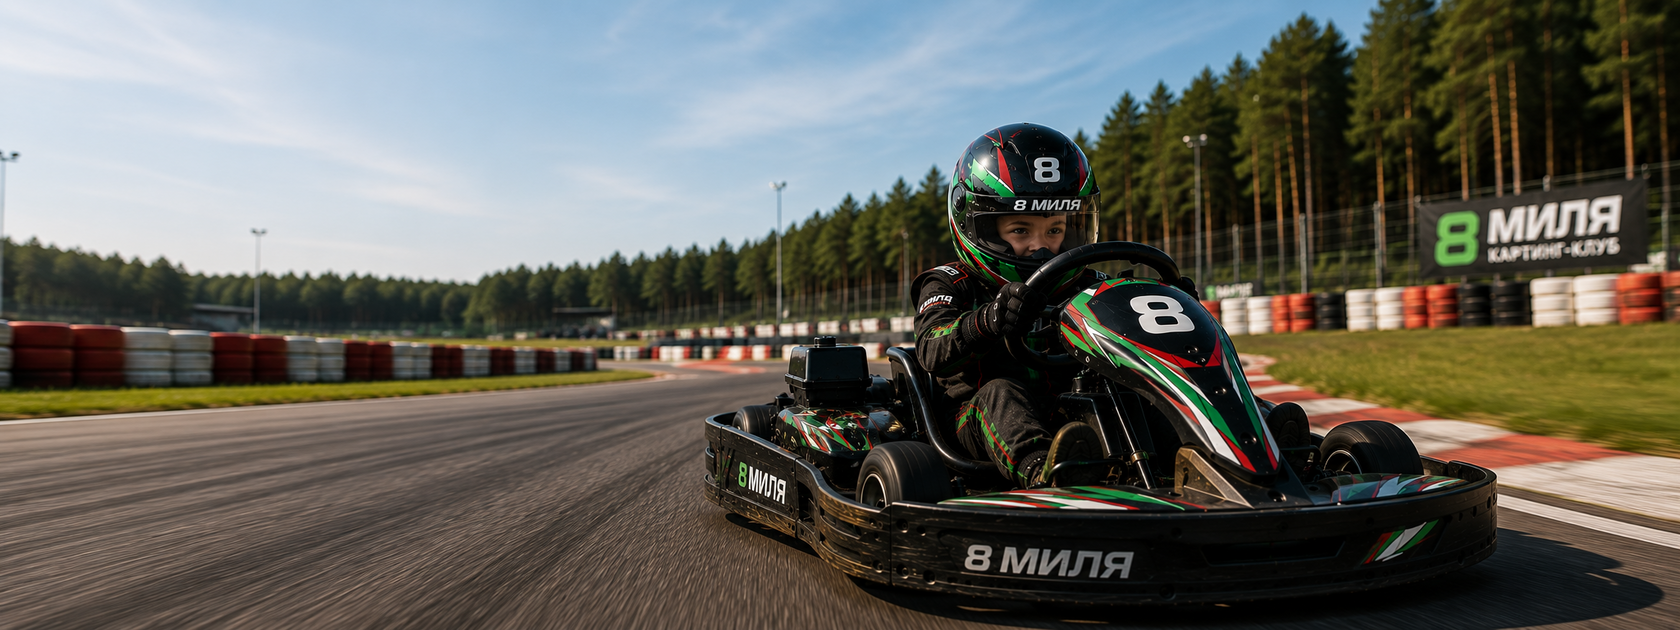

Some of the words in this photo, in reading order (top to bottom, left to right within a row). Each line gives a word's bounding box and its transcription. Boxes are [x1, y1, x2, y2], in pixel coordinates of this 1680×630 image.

[1033, 157, 1061, 183] 8
[1013, 199, 1027, 211] 8
[1031, 199, 1082, 211] МИЛЯ
[1434, 210, 1480, 267] 8
[1487, 195, 1623, 244] МИЛЯ
[1487, 237, 1621, 263] КАРТИНГ-КЛУБ
[1130, 295, 1195, 334] 8
[738, 461, 748, 488] 8
[748, 465, 787, 505] МИЛЯ
[964, 544, 993, 572] 8
[1000, 546, 1134, 579] МИЛЯ
